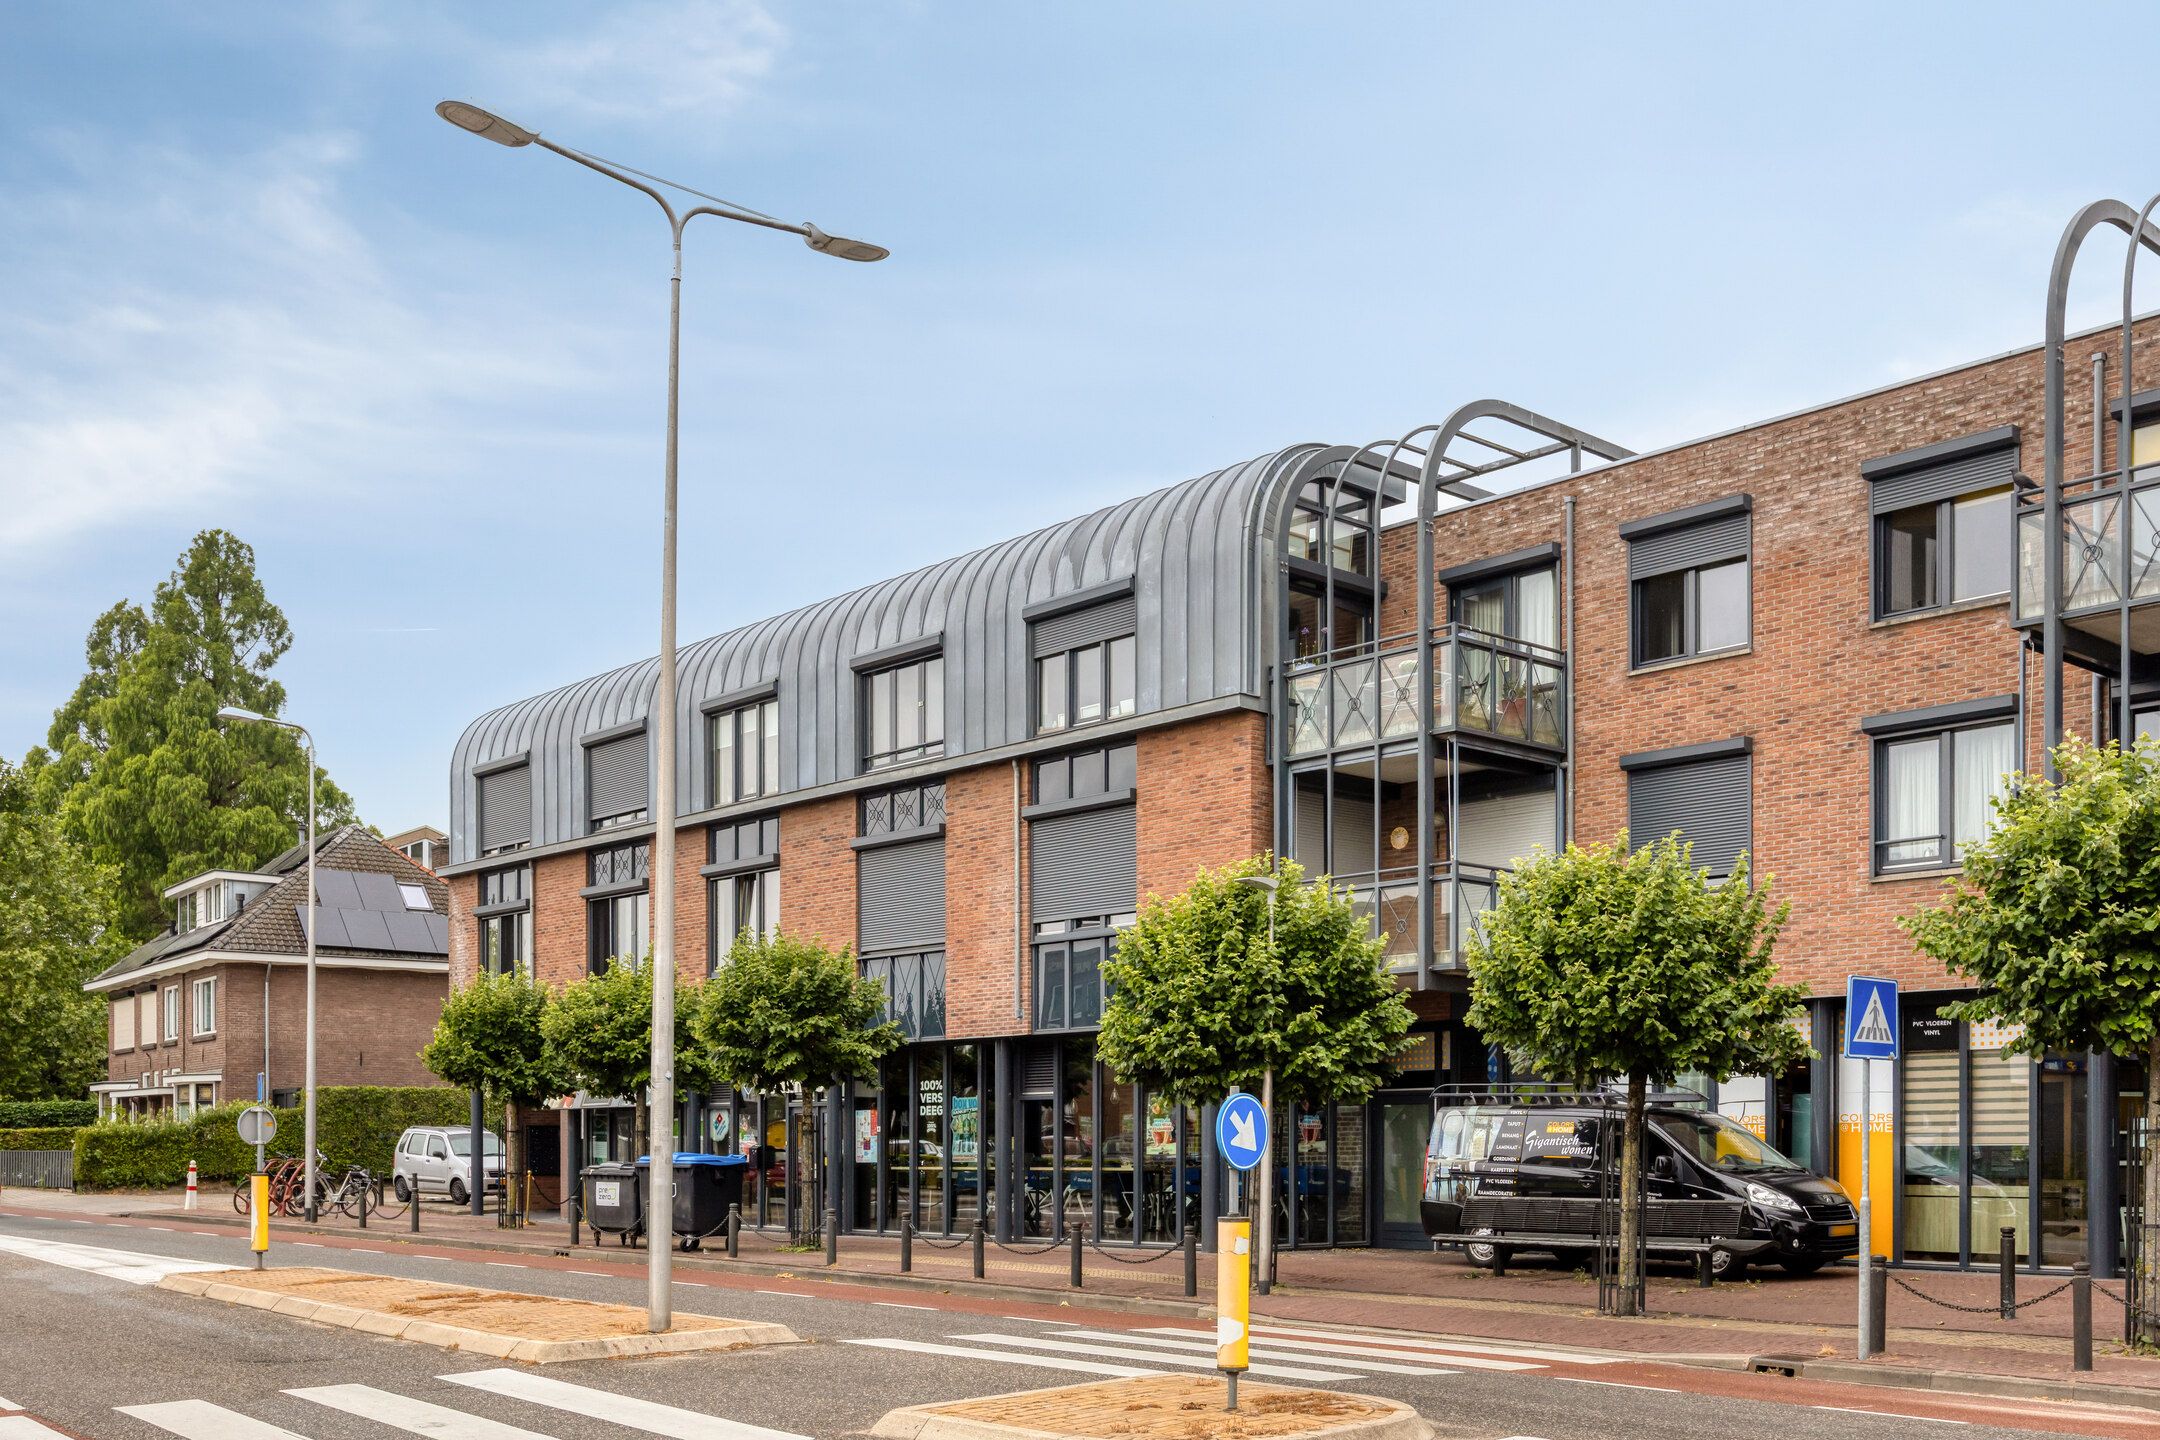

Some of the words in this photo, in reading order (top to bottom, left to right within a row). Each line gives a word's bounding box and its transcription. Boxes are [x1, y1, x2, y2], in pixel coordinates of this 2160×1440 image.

[920, 1080, 943, 1090] 100%
[920, 1093, 943, 1103] VERS
[920, 1106, 943, 1116] DEEG
[1727, 1115, 1765, 1124] OLORS
[1525, 1130, 1580, 1152] Gigantisch
[1561, 1145, 1594, 1155] wonen
